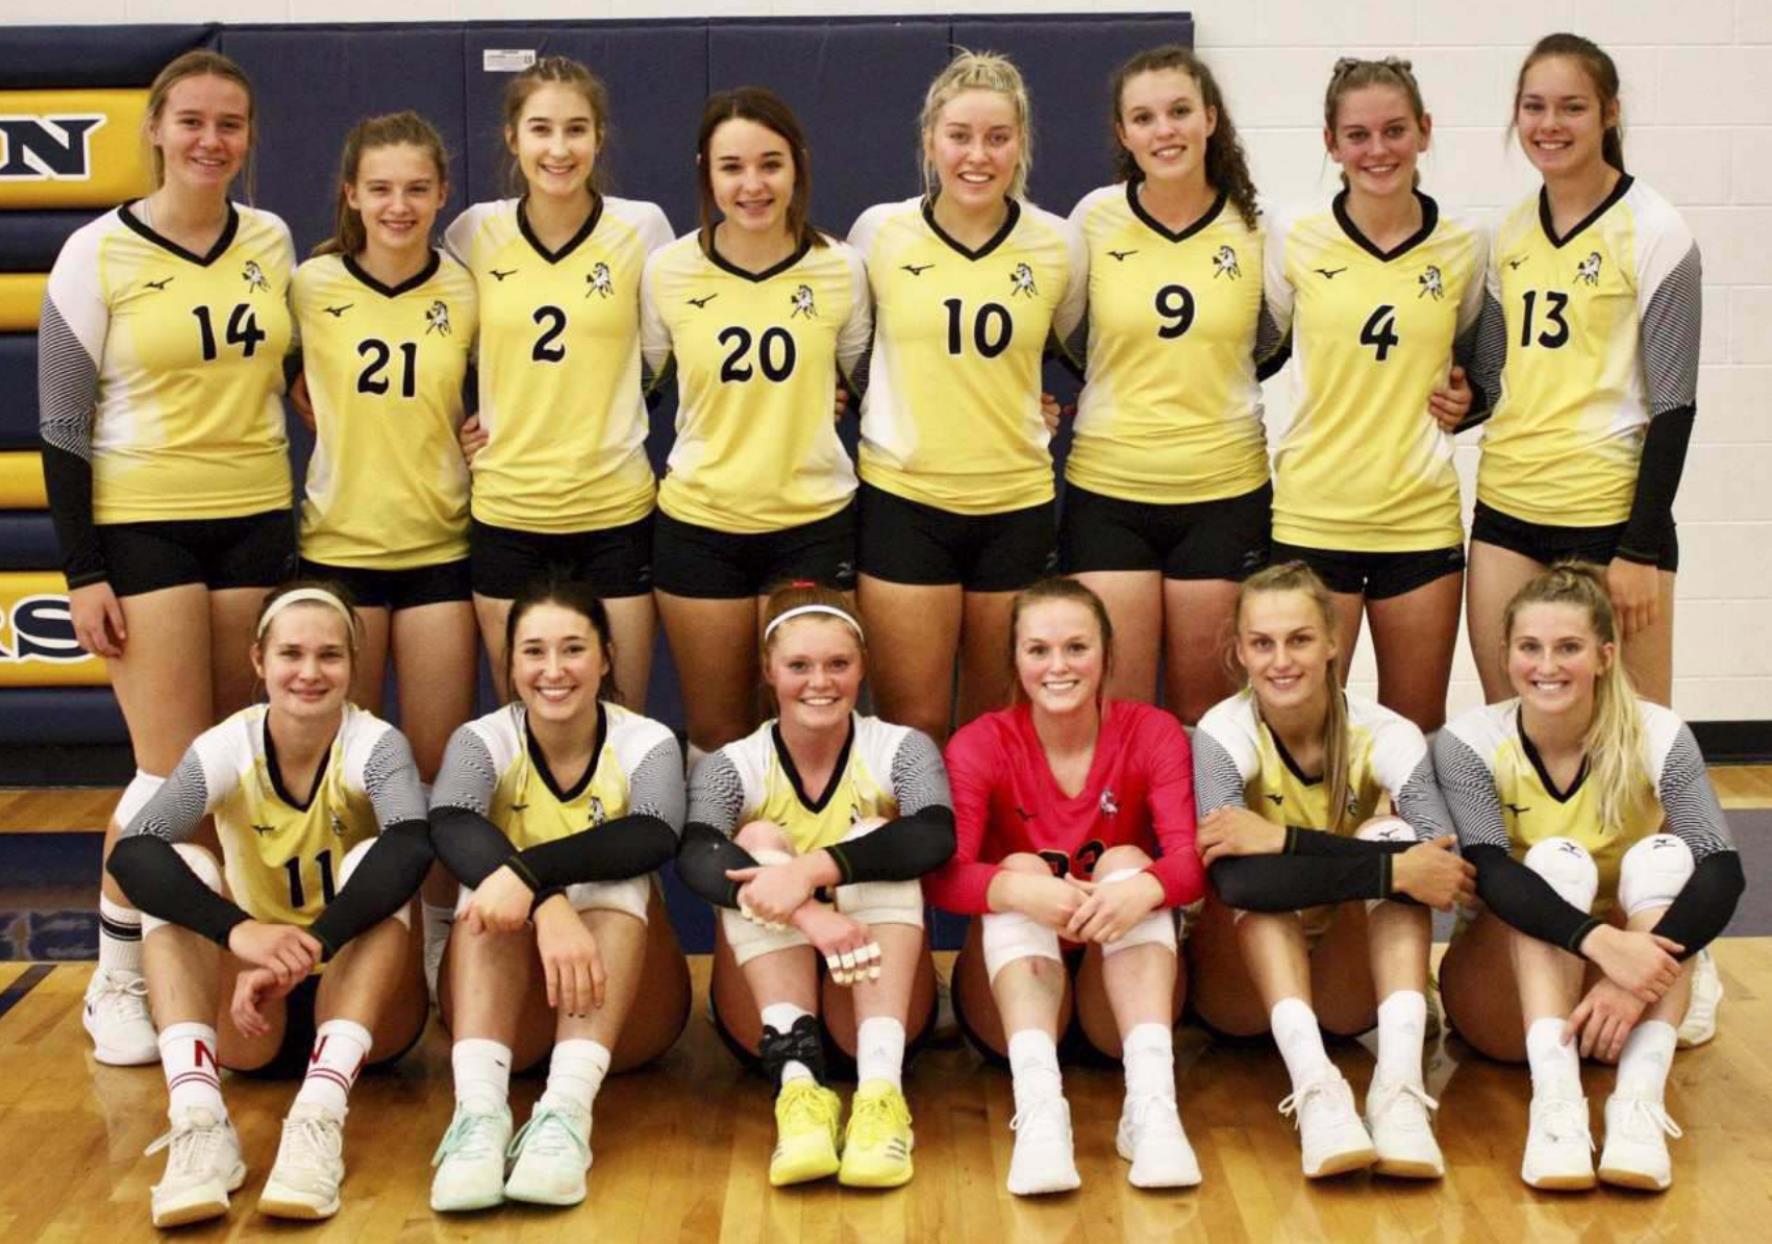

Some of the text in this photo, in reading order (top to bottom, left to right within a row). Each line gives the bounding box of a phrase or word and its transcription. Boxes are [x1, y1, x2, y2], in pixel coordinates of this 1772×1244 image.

[192, 303, 267, 362] 14
[532, 305, 567, 363] 2
[944, 298, 1014, 359] 10
[1155, 284, 1196, 339] 9
[1360, 305, 1400, 361] 4
[1521, 290, 1570, 349] 13
[357, 339, 418, 398] 21
[718, 326, 797, 383] 20
[283, 848, 336, 909] 11
